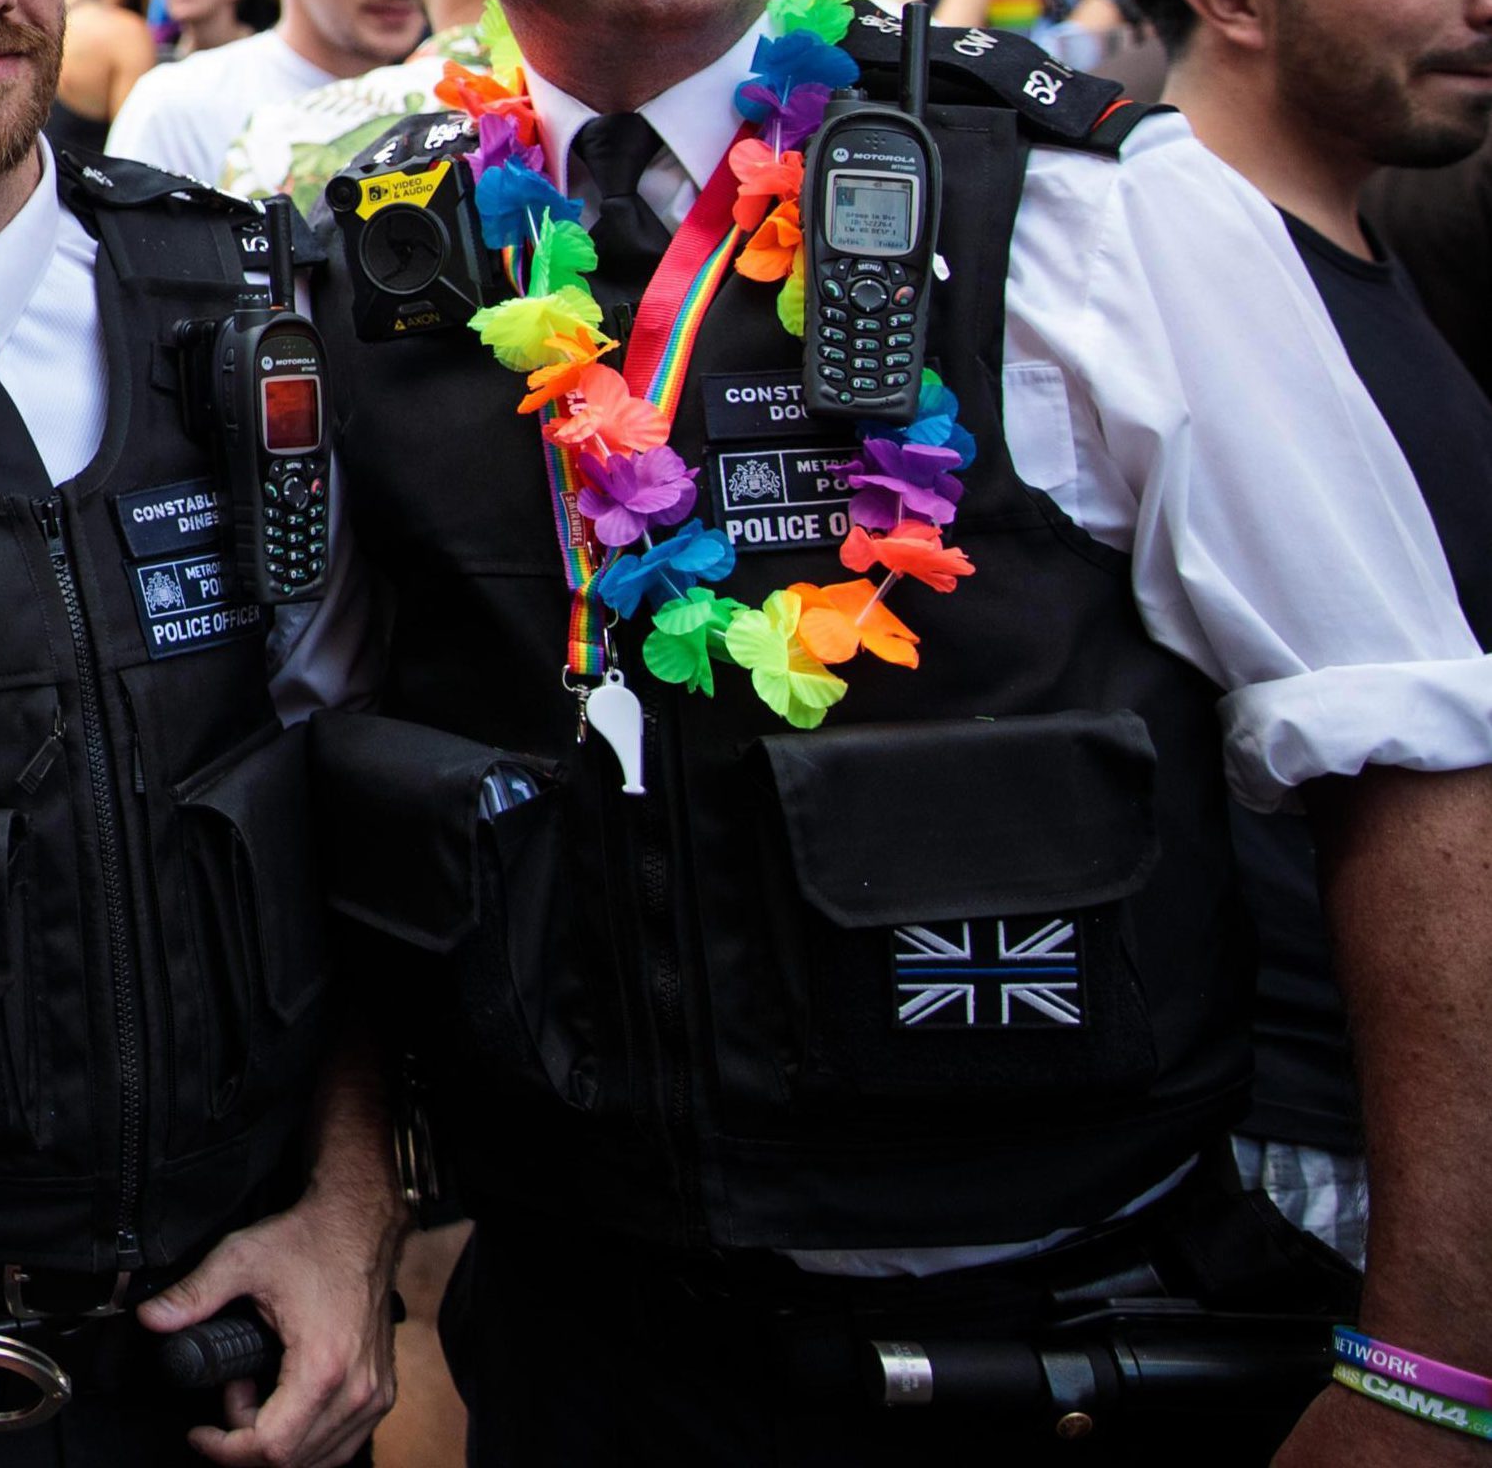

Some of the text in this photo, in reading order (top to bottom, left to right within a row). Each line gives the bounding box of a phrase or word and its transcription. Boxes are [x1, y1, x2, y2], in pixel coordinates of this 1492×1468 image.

[853, 153, 915, 163] MOTOROLA
[393, 178, 422, 191] VIDEO
[403, 184, 433, 197] AUDIO
[858, 264, 881, 272] MENU
[407, 313, 440, 326] AXON
[826, 310, 832, 318] 1
[857, 321, 864, 329] 2
[890, 317, 898, 326] 3
[823, 329, 830, 337] 4
[856, 340, 863, 349] 5
[889, 337, 895, 346] 6
[276, 358, 315, 366] MOTOROLA
[823, 348, 830, 356] 7
[854, 360, 862, 368] 8
[886, 357, 894, 365] 9
[853, 379, 860, 387] 0
[726, 514, 821, 545] POLICE
[268, 545, 274, 553] 7
[153, 604, 261, 645] POLICE OFFICER
[1335, 1336, 1419, 1379] NETWORK
